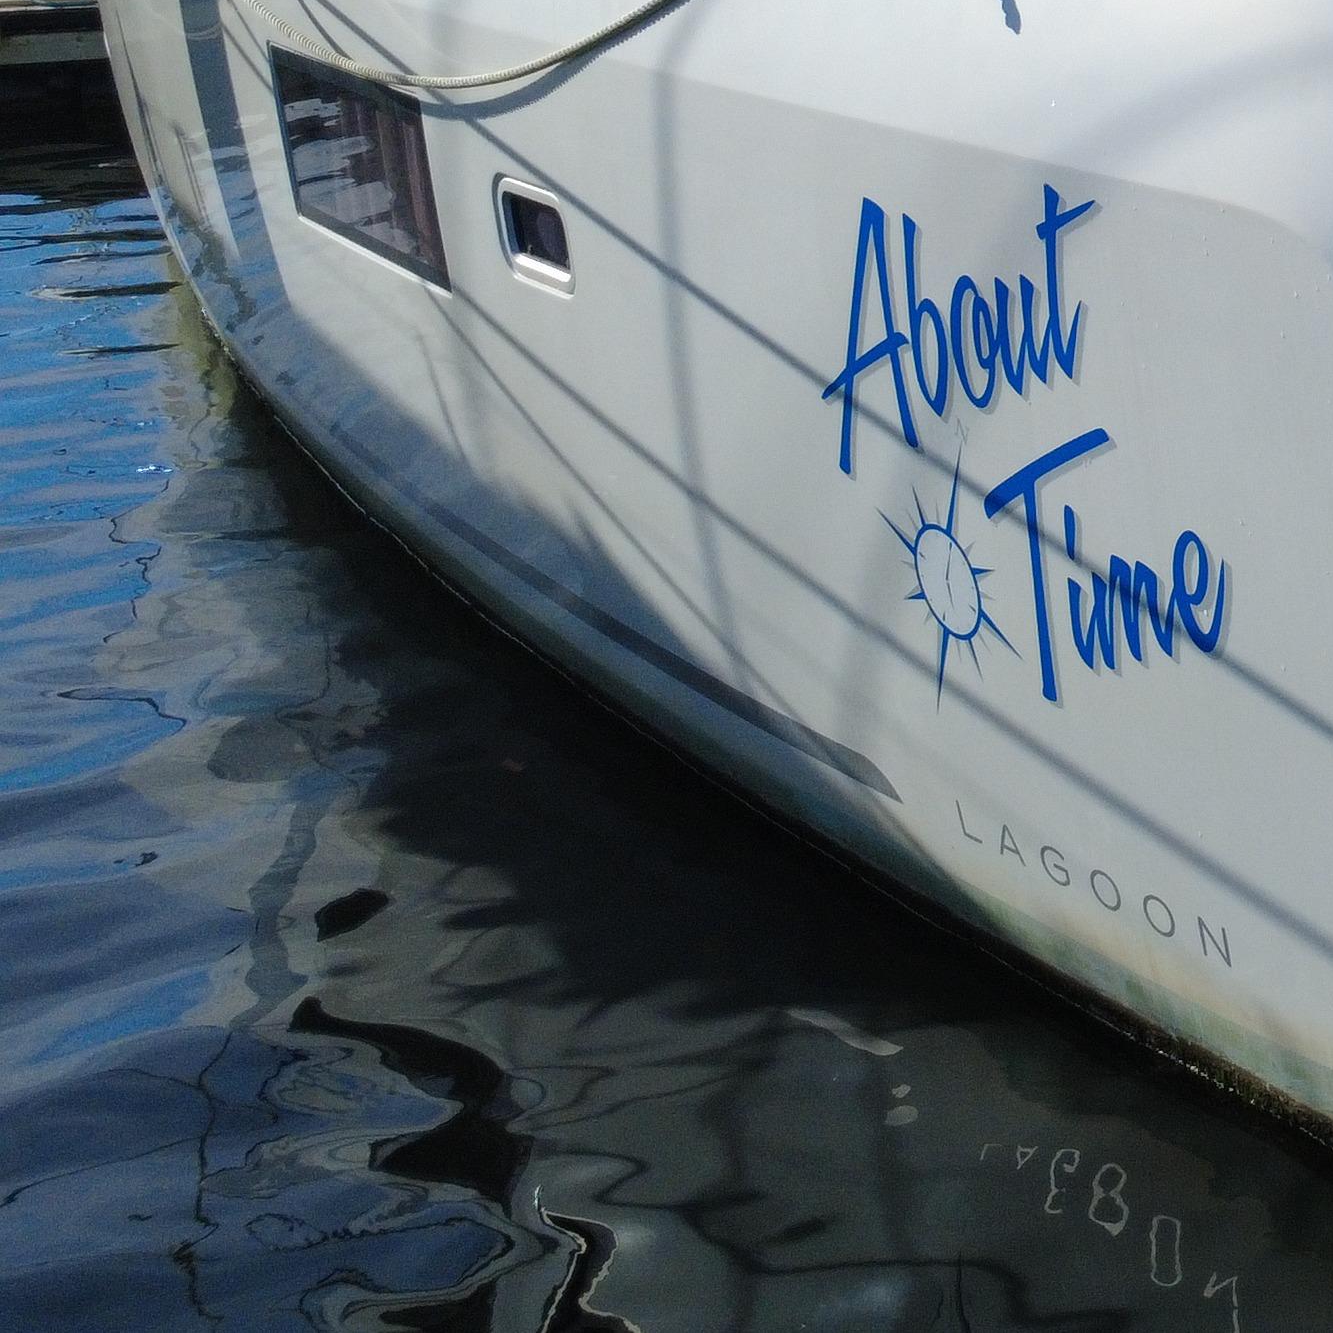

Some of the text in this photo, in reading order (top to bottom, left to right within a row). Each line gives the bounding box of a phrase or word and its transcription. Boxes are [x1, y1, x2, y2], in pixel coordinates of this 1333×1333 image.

[822, 183, 1097, 475] About
[984, 427, 1230, 704] Time
[956, 798, 1233, 968] LAGOON
